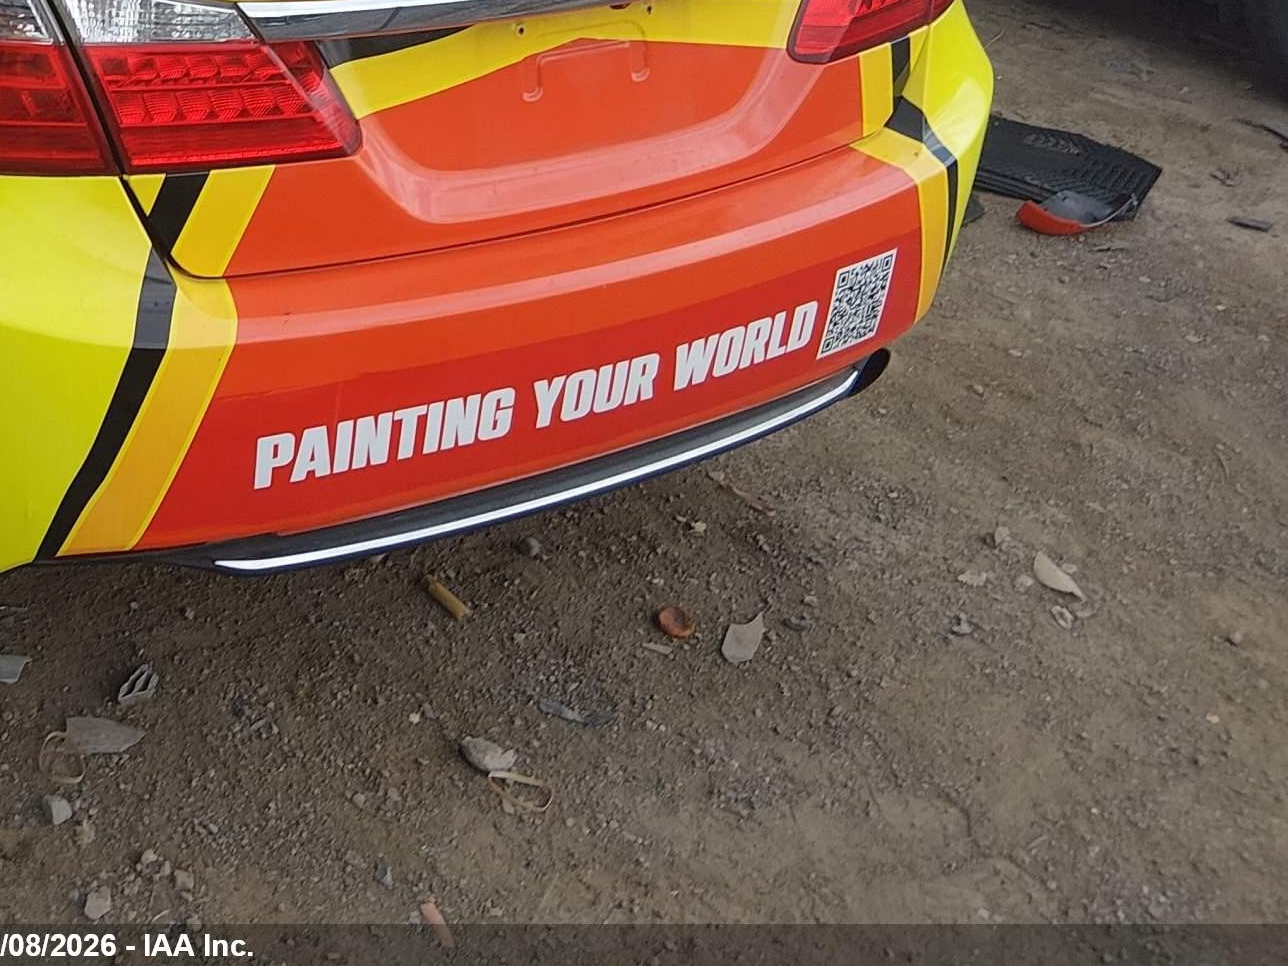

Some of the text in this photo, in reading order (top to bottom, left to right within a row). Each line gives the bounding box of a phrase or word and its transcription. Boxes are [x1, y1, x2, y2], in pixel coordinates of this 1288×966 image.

[253, 300, 819, 490] PAINTING YOUR WORLD
